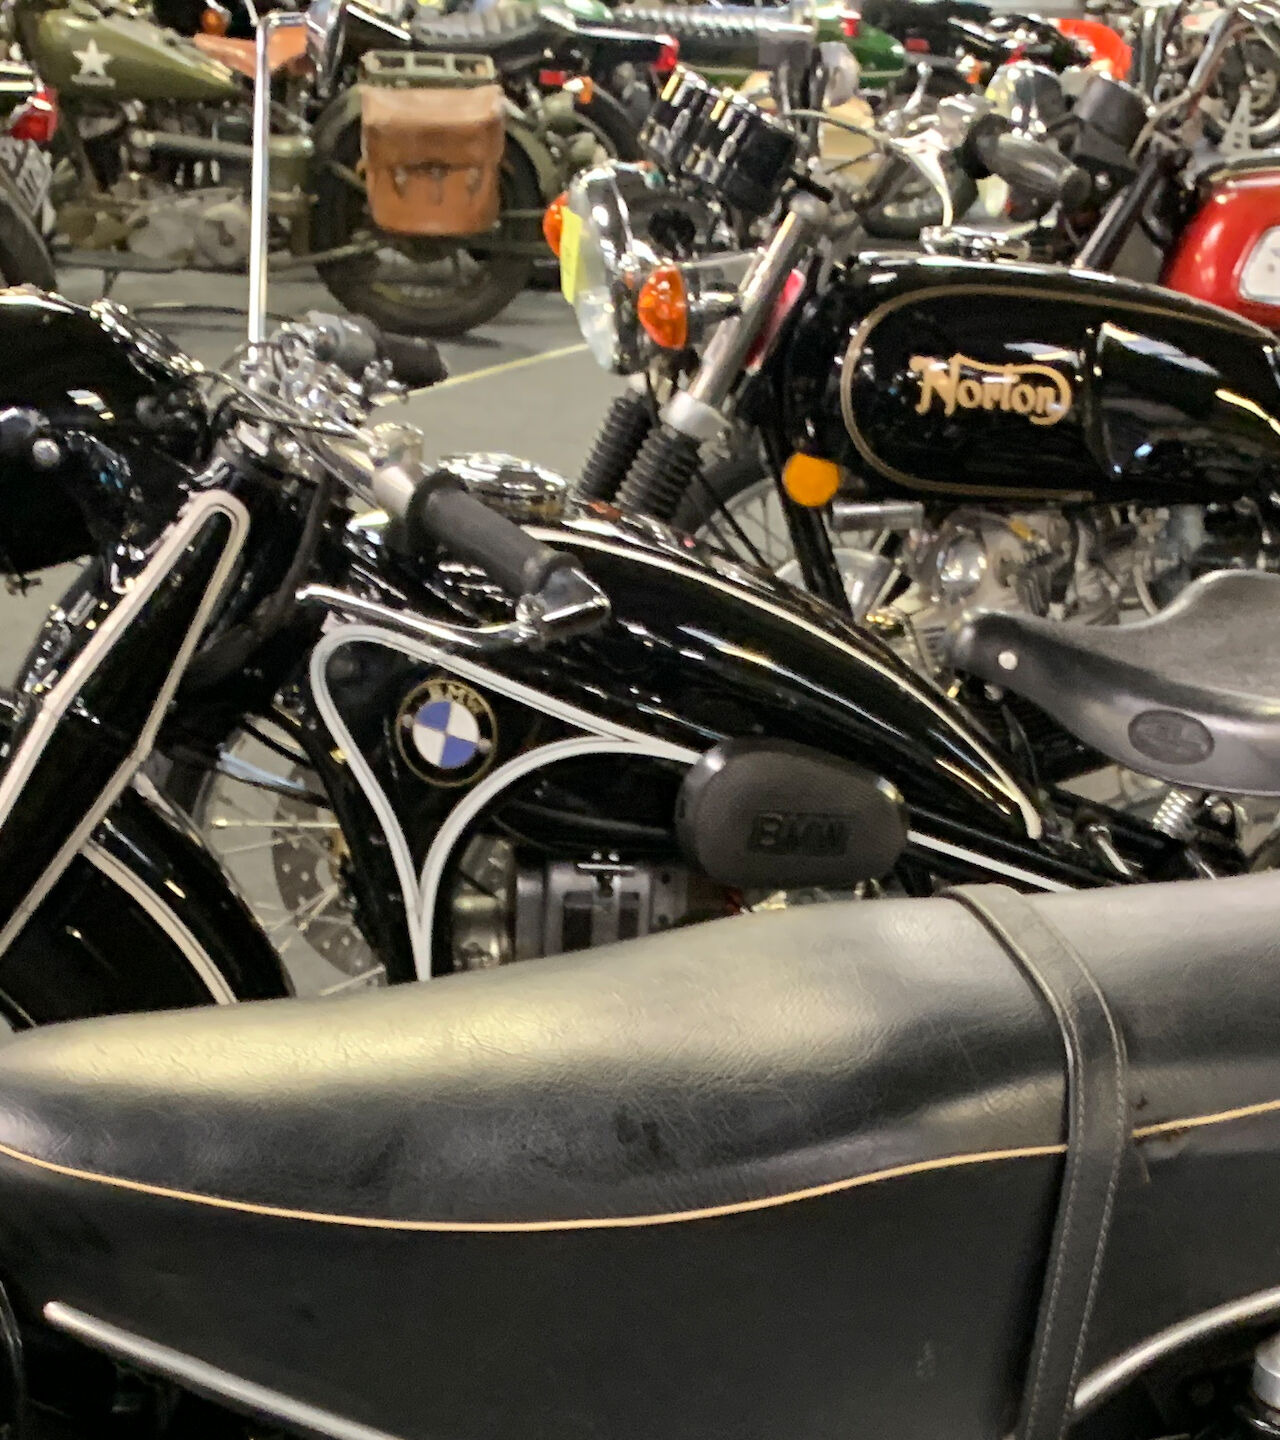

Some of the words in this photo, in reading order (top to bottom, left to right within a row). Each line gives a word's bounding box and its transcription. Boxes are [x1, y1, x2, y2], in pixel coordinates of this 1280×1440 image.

[908, 352, 1072, 426] Norton
[427, 682, 486, 714] BMW
[747, 811, 856, 857] BMW
